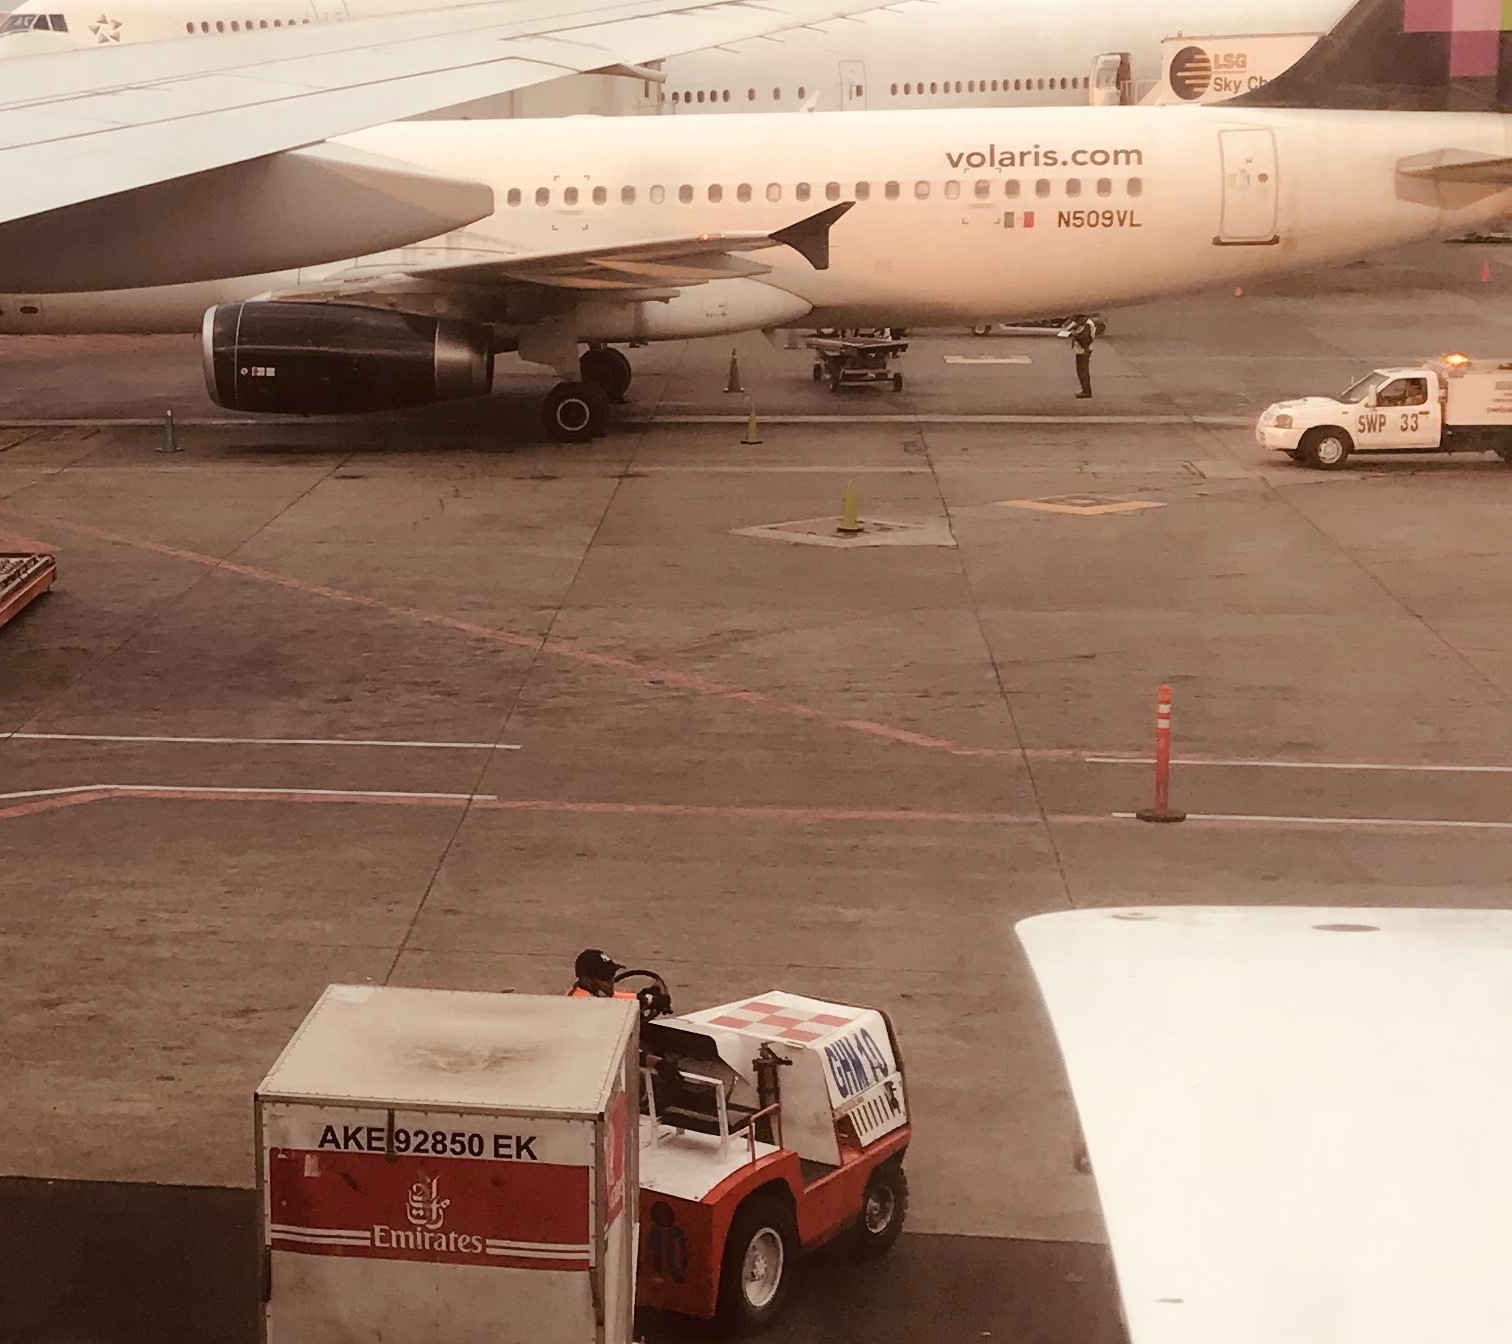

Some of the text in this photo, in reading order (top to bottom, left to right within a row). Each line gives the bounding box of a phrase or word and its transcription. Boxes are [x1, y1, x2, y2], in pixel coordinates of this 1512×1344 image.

[1213, 53, 1247, 70] LSG
[1213, 77, 1242, 95] Sky
[945, 143, 1143, 168] volaris.com
[1057, 210, 1142, 228] N509VL
[1358, 413, 1419, 434] SWP 33
[317, 1124, 538, 1160] AKE 92850 EK
[372, 1224, 484, 1254] Emirates
